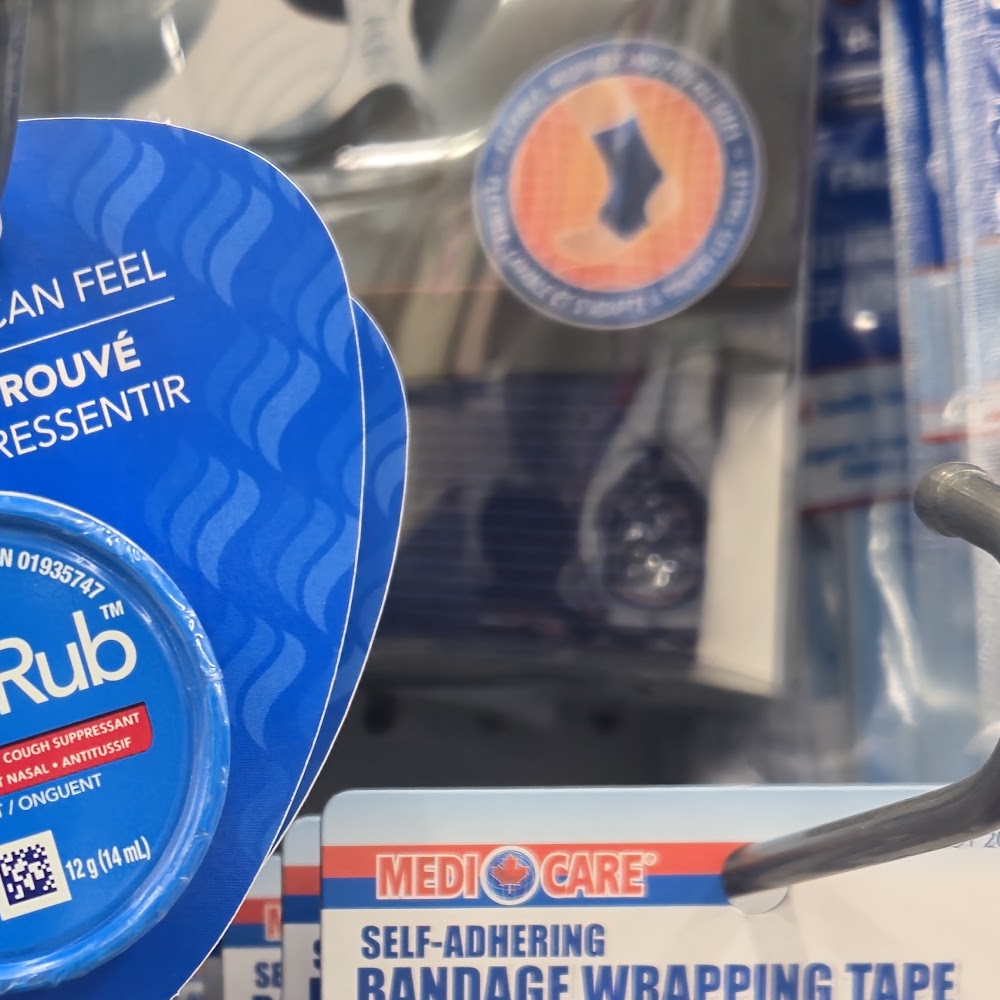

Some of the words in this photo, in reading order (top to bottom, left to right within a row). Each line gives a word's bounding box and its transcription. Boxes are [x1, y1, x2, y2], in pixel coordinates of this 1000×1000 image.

[75, 248, 167, 303] FEEL
[16, 551, 106, 600] 01935747
[2, 742, 52, 765] COUGH
[52, 711, 141, 750] SUPPRESSANT
[6, 764, 50, 785] NASAL
[61, 737, 133, 768] ANTITUSSIF
[18, 772, 103, 811] ONGUENT
[65, 858, 86, 881] 12
[86, 860, 99, 880] g
[98, 846, 122, 874] (14
[122, 836, 152, 863] mL)
[360, 923, 606, 960] SELF-ADHERING
